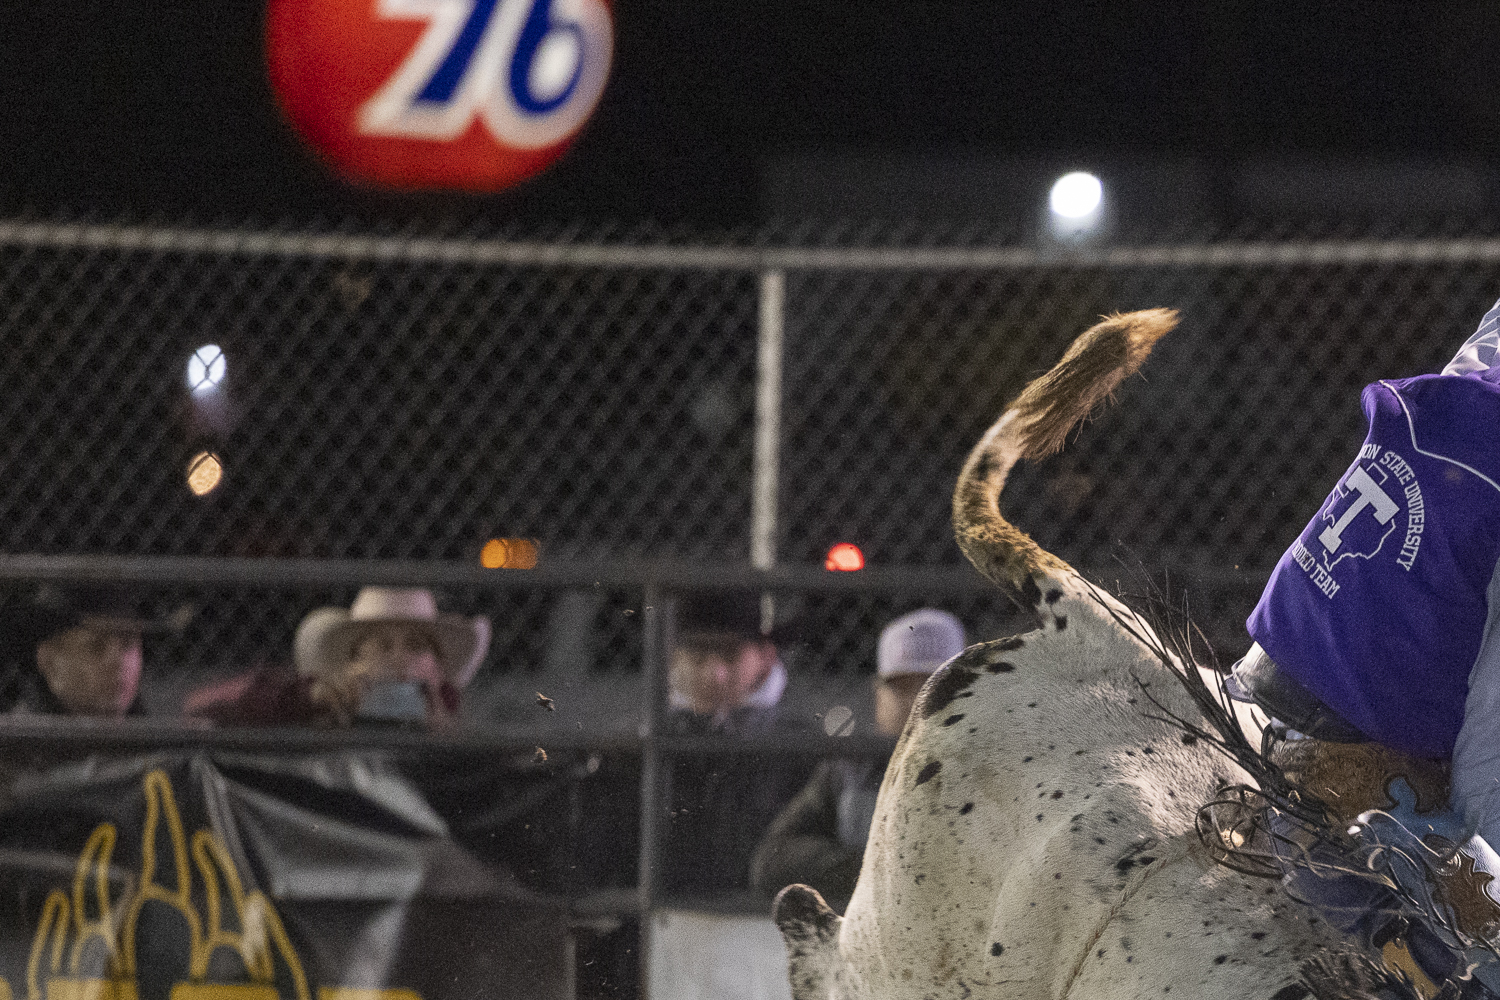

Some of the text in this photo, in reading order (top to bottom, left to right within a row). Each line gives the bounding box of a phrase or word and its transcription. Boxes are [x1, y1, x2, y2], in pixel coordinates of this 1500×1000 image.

[357, 0, 612, 150] 76
[1379, 450, 1416, 486] STATE
[1396, 480, 1425, 572] UNIVERSITY
[1309, 562, 1341, 600] TEAM
